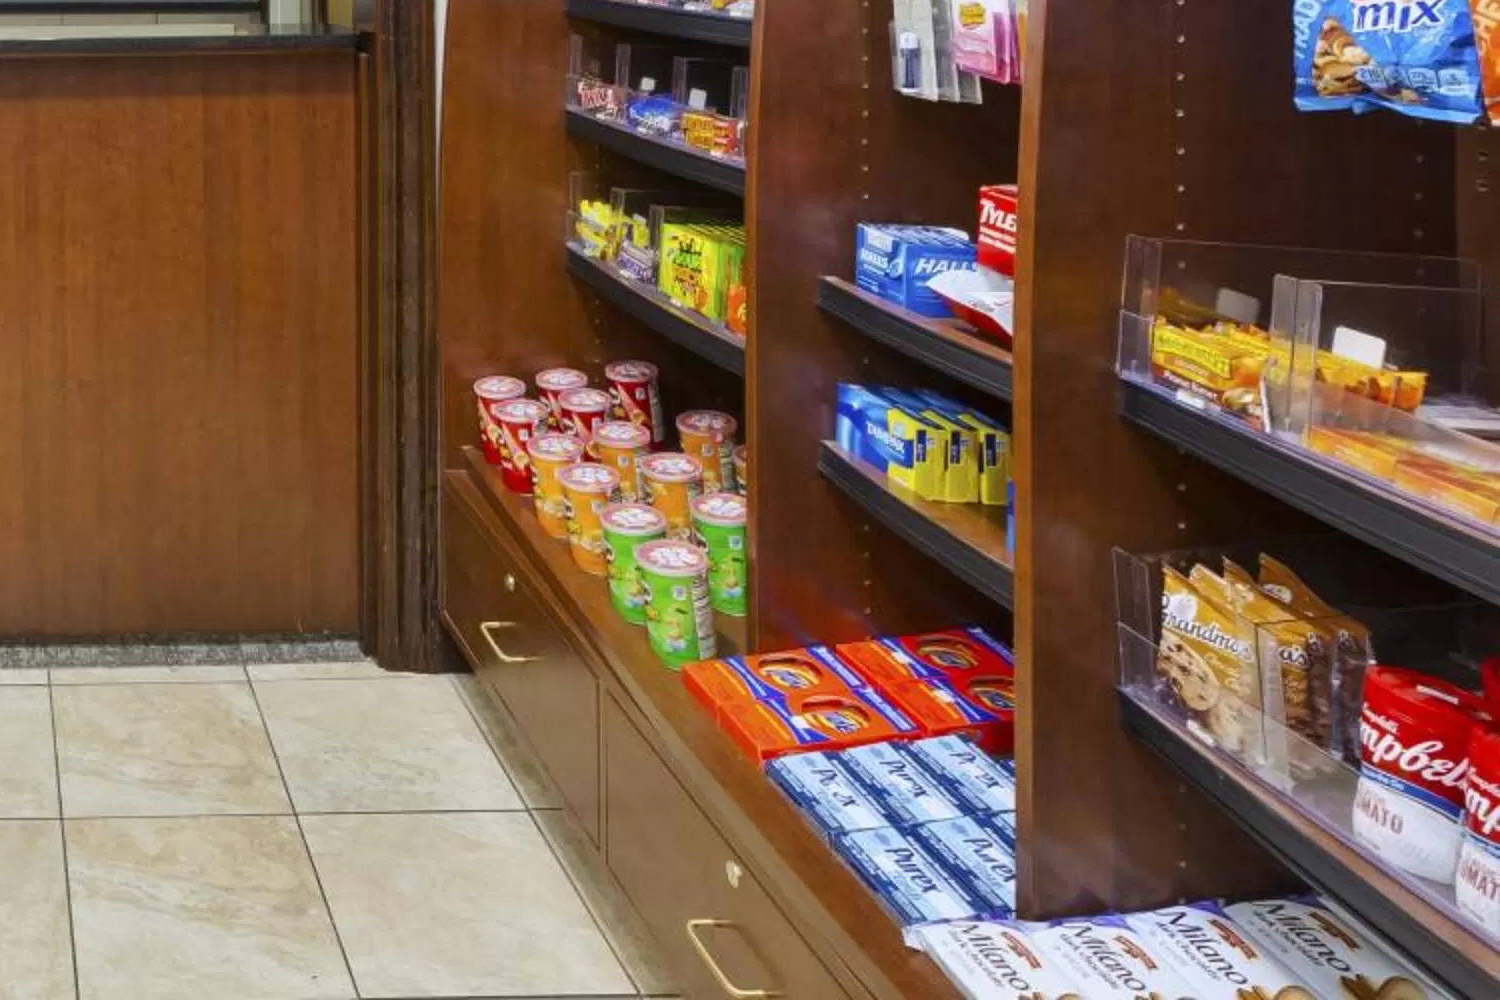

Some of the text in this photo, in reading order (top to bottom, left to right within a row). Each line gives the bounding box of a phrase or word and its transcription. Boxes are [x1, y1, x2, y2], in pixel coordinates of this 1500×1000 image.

[884, 846, 940, 894] Purex
[952, 923, 1029, 991] Milano
[1064, 925, 1146, 991] Milano
[1155, 910, 1249, 985] Milano
[1251, 902, 1352, 973] Milano
